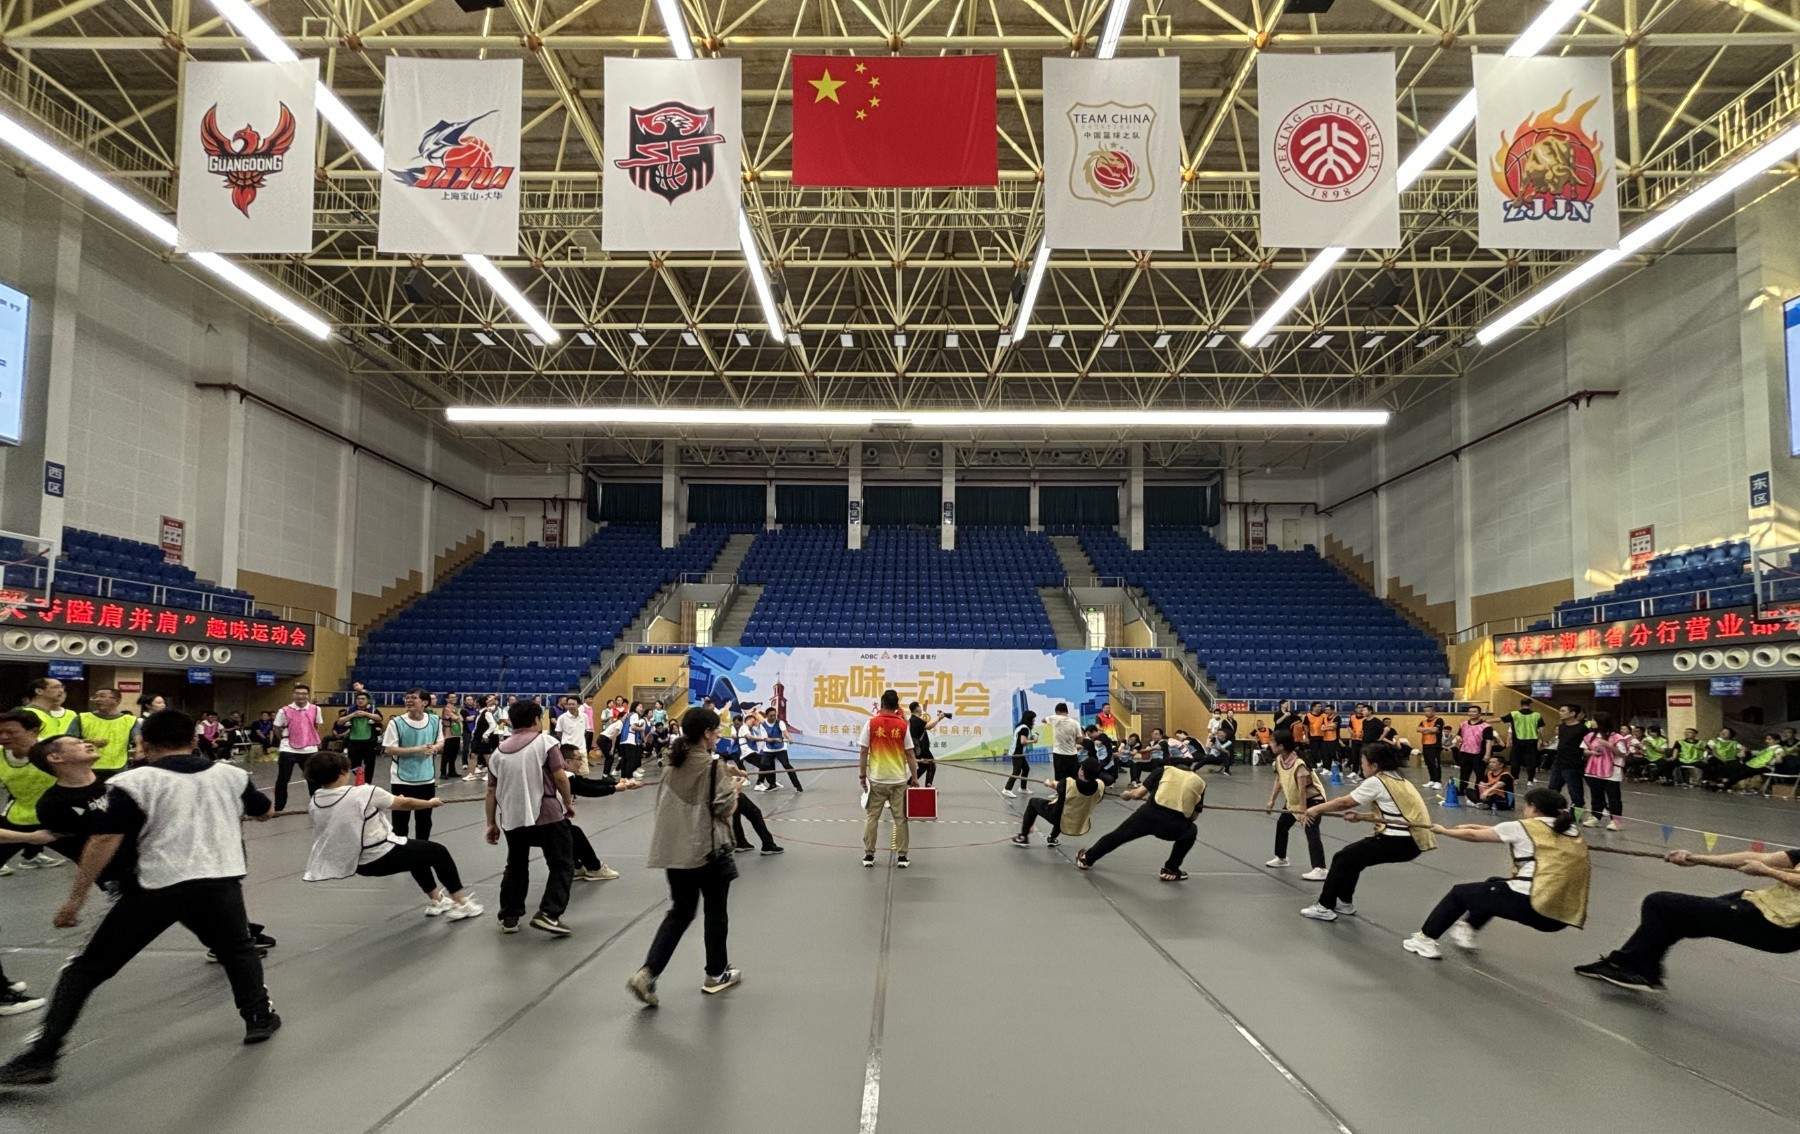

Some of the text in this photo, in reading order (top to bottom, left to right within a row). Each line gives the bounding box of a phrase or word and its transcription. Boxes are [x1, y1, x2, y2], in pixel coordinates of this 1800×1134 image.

[1073, 113, 1151, 124] TEAM CHINA
[1083, 131, 1140, 140] 中国篮球之队
[1278, 103, 1380, 174] PEKING UNIVERSITY
[1310, 187, 1352, 199] 1898
[48, 465, 63, 495] 西区
[1752, 477, 1768, 506] 东区
